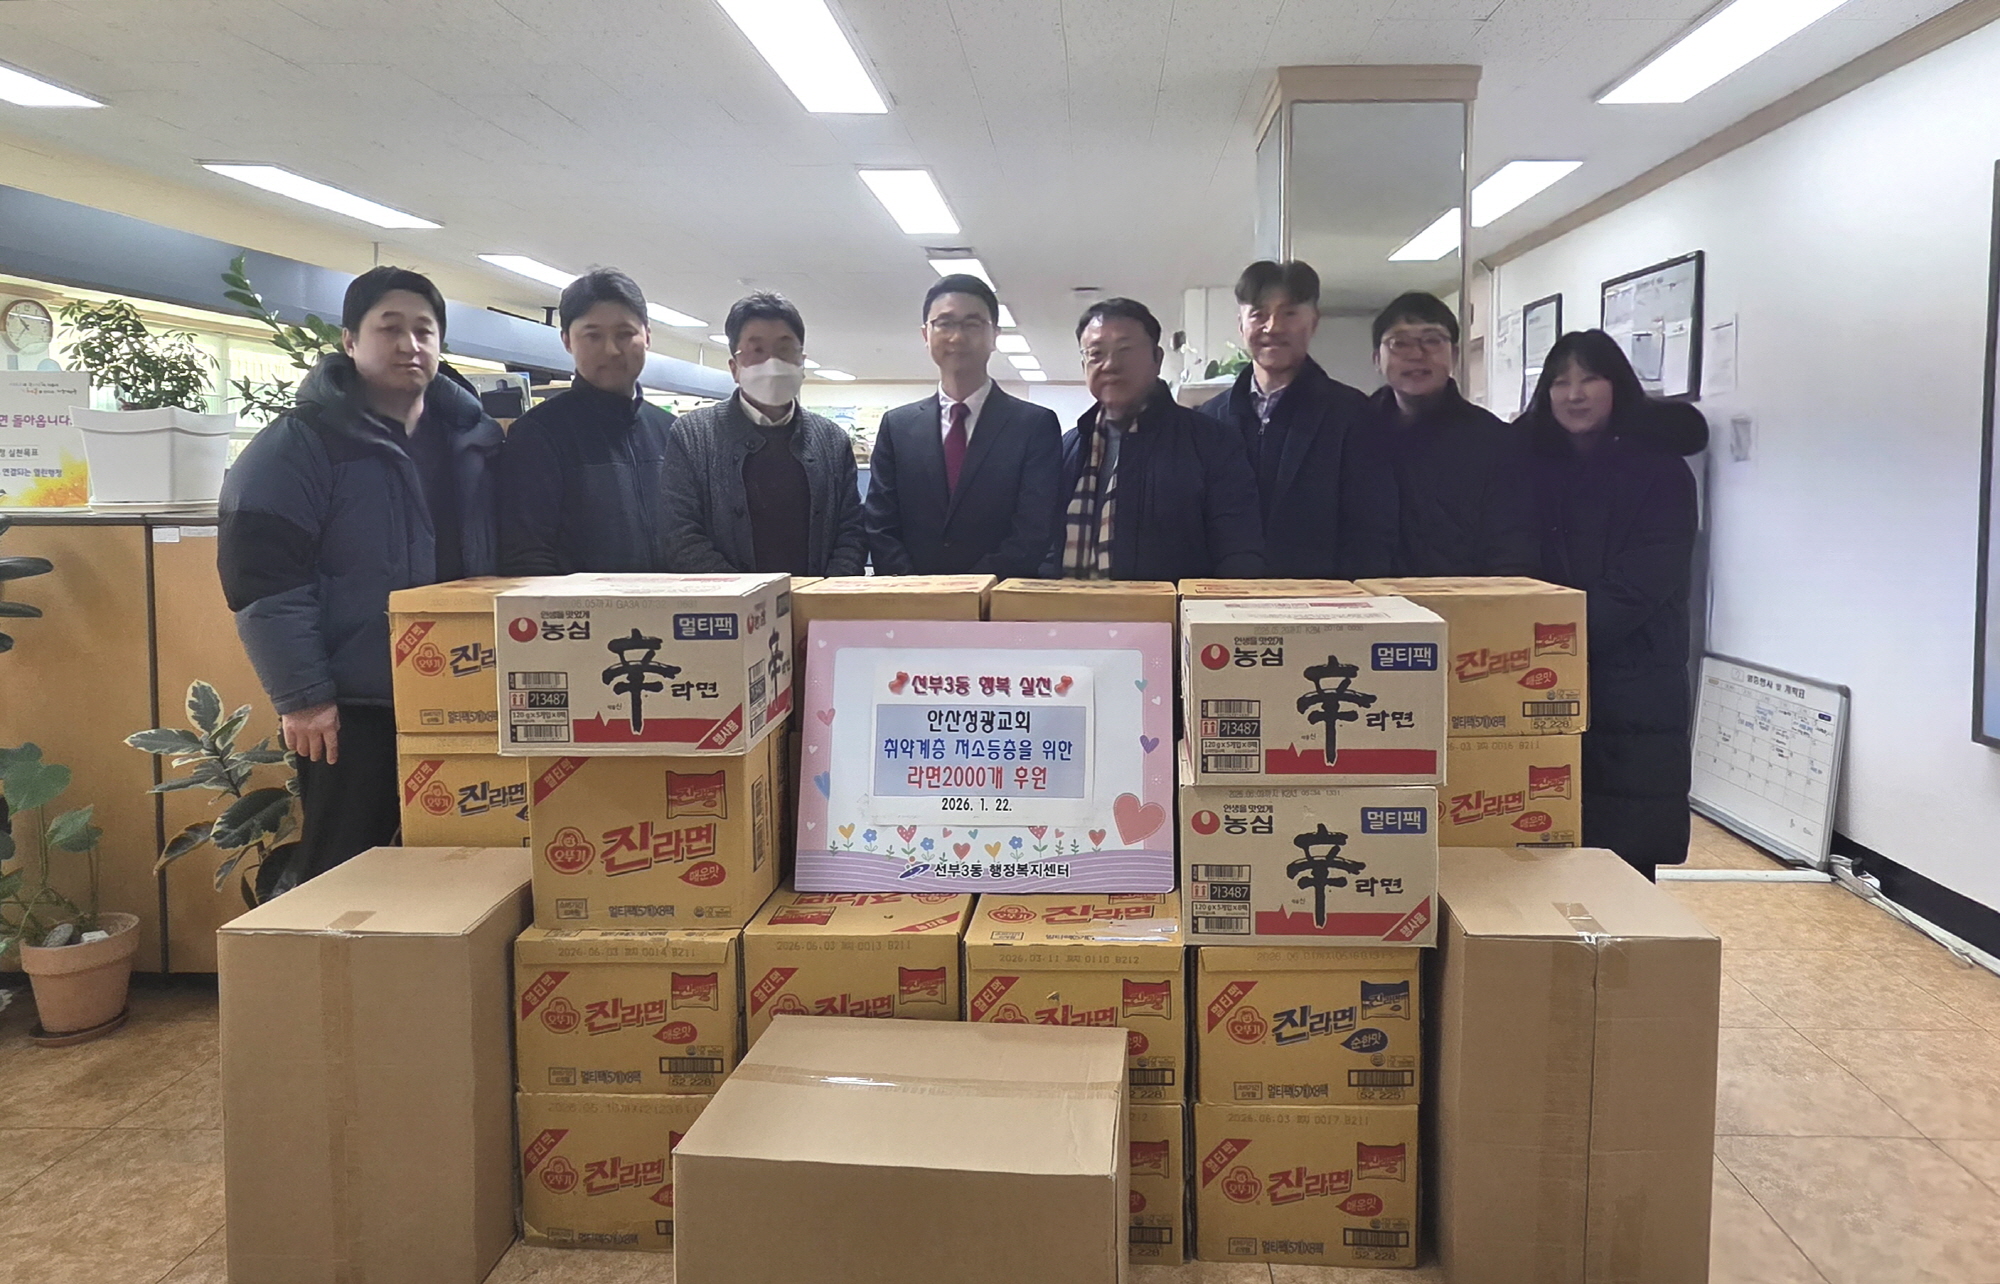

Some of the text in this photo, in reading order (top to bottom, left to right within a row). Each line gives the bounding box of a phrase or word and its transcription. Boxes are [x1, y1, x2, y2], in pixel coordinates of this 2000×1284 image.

[12, 414, 73, 428] 돌아옵니다.
[9, 448, 38, 458] 실천목표
[541, 620, 590, 640] 농심
[678, 616, 732, 636] 멀티팩
[1234, 636, 1284, 645] 인생을 맛있게
[419, 660, 440, 669] 오뚜기
[450, 642, 496, 678] 진라
[1234, 648, 1284, 666] 농심
[1378, 648, 1432, 667] 멀티팩
[1456, 648, 1530, 682] 진라면
[602, 628, 682, 735] 辛
[911, 675, 1052, 696] 선부3동 행복 실천
[1526, 672, 1552, 686] 매운맛
[530, 693, 566, 706] 가3487
[670, 681, 720, 700] 라면
[1296, 655, 1378, 766] 辛
[928, 710, 1030, 733] 안산성광교회
[1221, 722, 1258, 736] 가3487
[1366, 710, 1414, 731] 라면
[1534, 720, 1570, 729] 52 228
[712, 719, 740, 746] 행사용
[884, 738, 1072, 761] 취약계층 저소등층을 위한
[908, 766, 1048, 790] 라면2000개 후원
[428, 798, 449, 808] 오뚜기
[458, 781, 527, 816] 진라면
[941, 798, 1012, 812] 2026. 1. 22.
[1223, 804, 1274, 814] 인생을 맛있게
[1450, 790, 1525, 826] 진라면
[1223, 815, 1274, 834] 농심
[1367, 811, 1422, 830] 멀티팩
[1520, 815, 1546, 828] 매운맛
[554, 850, 587, 862] 오뚜기
[600, 820, 716, 878] 진라면
[689, 865, 720, 882] 매운맛
[934, 863, 1070, 878] 선부3동 행정복지센터
[1286, 823, 1366, 929] 辛
[1212, 886, 1248, 898] 가3487
[1356, 878, 1404, 896] 라면
[1042, 904, 1155, 925] 진라면
[1399, 913, 1428, 938] 행사용
[973, 979, 1006, 1012] 멀티팩
[1210, 984, 1244, 1018] 멀티팩
[548, 1014, 574, 1026] 오뚜기
[585, 998, 668, 1036] 진라면
[1272, 1004, 1357, 1046] 진라면
[662, 1026, 692, 1040] 매운맛
[1235, 1026, 1260, 1036] 오뚜기
[1350, 1032, 1382, 1050] 순한맛
[690, 1078, 712, 1086] 228
[1140, 1090, 1162, 1098] 228
[1360, 1091, 1374, 1099] 52
[1130, 1113, 1148, 1122] 212
[1206, 1140, 1238, 1174] 멀티팩
[548, 1174, 572, 1185] 오뚜기
[584, 1156, 664, 1196] 진라면
[1228, 1182, 1256, 1194] 오뚜기
[1267, 1166, 1352, 1206] 진라면
[1346, 1196, 1376, 1212] 매운맛
[1374, 1252, 1397, 1260] 228
